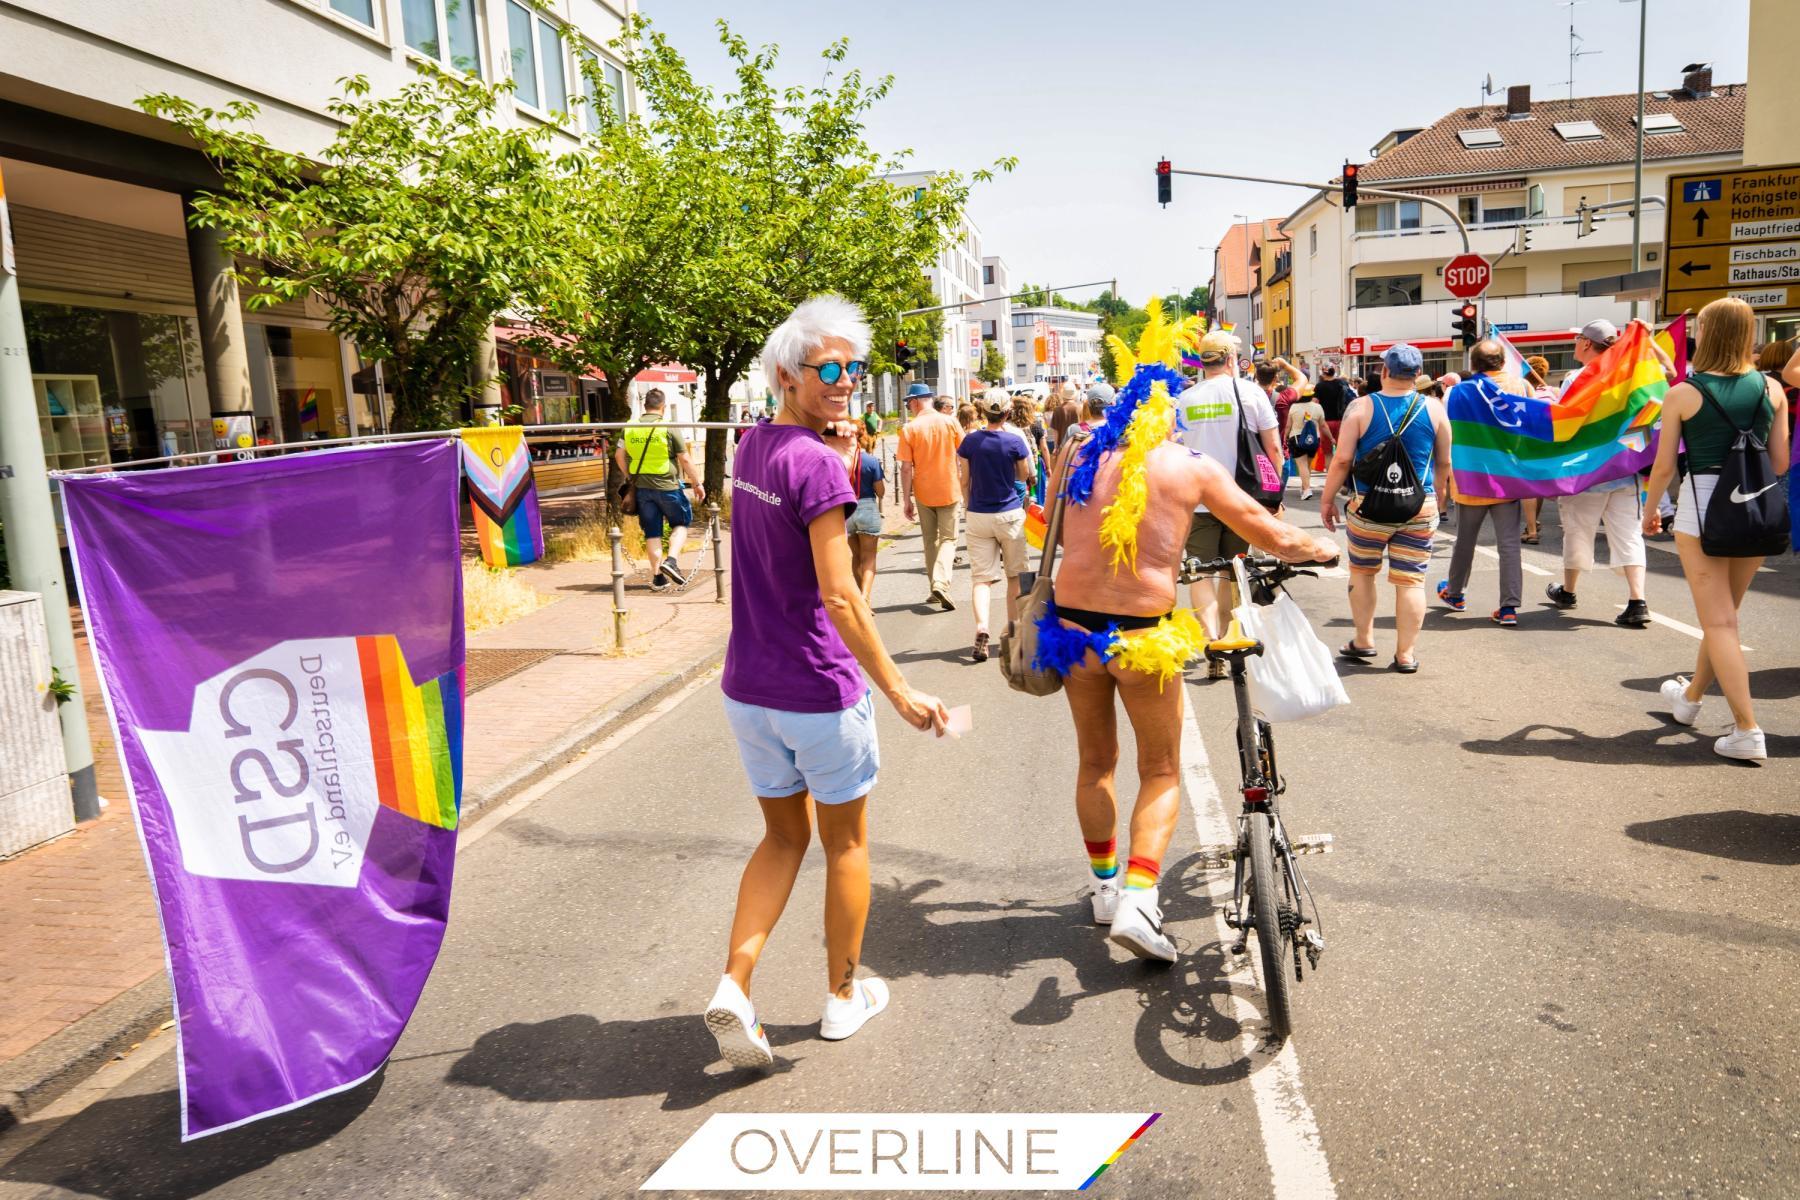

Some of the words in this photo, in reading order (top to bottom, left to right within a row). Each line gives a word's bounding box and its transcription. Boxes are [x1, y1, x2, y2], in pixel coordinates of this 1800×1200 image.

[1731, 190, 1800, 205] Königste
[1731, 205, 1794, 219] Hofheim
[1735, 223, 1800, 237] Hauptfried
[1733, 247, 1796, 260] Fischbach
[1447, 265, 1487, 287] STOP
[1733, 265, 1800, 281] Rathaus/Sta
